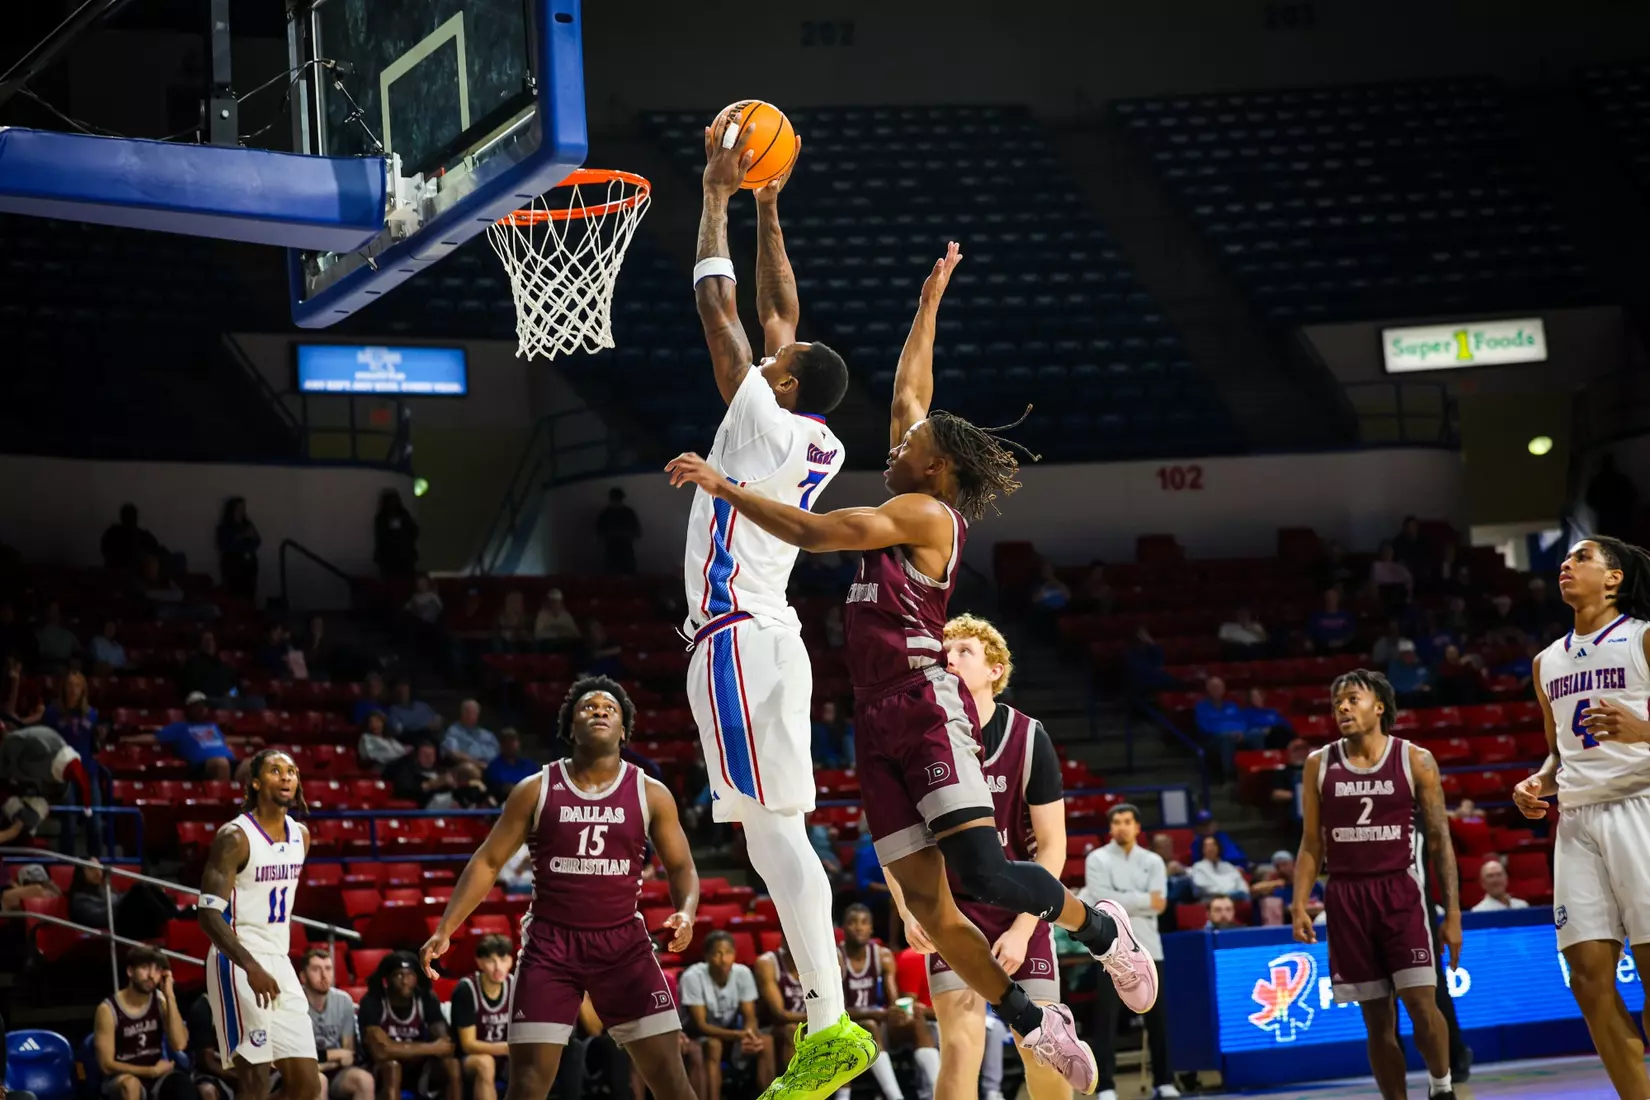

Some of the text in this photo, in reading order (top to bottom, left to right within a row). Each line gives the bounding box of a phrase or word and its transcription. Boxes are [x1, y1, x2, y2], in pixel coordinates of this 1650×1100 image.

[1454, 328, 1473, 360] 1
[1474, 328, 1535, 350] Foods
[797, 469, 829, 511] 7
[1156, 465, 1204, 490] 102
[1546, 667, 1626, 703] LOUISIANA TECH
[1335, 780, 1395, 797] DALLAS
[559, 805, 625, 824] DALLAS
[1356, 797, 1374, 825] 2
[576, 824, 609, 856] 15
[1331, 825, 1401, 842] CHRISTIAN
[255, 865, 289, 883] LOUISIANA
[549, 856, 631, 876] CHRISTIAN
[267, 886, 288, 924] 11
